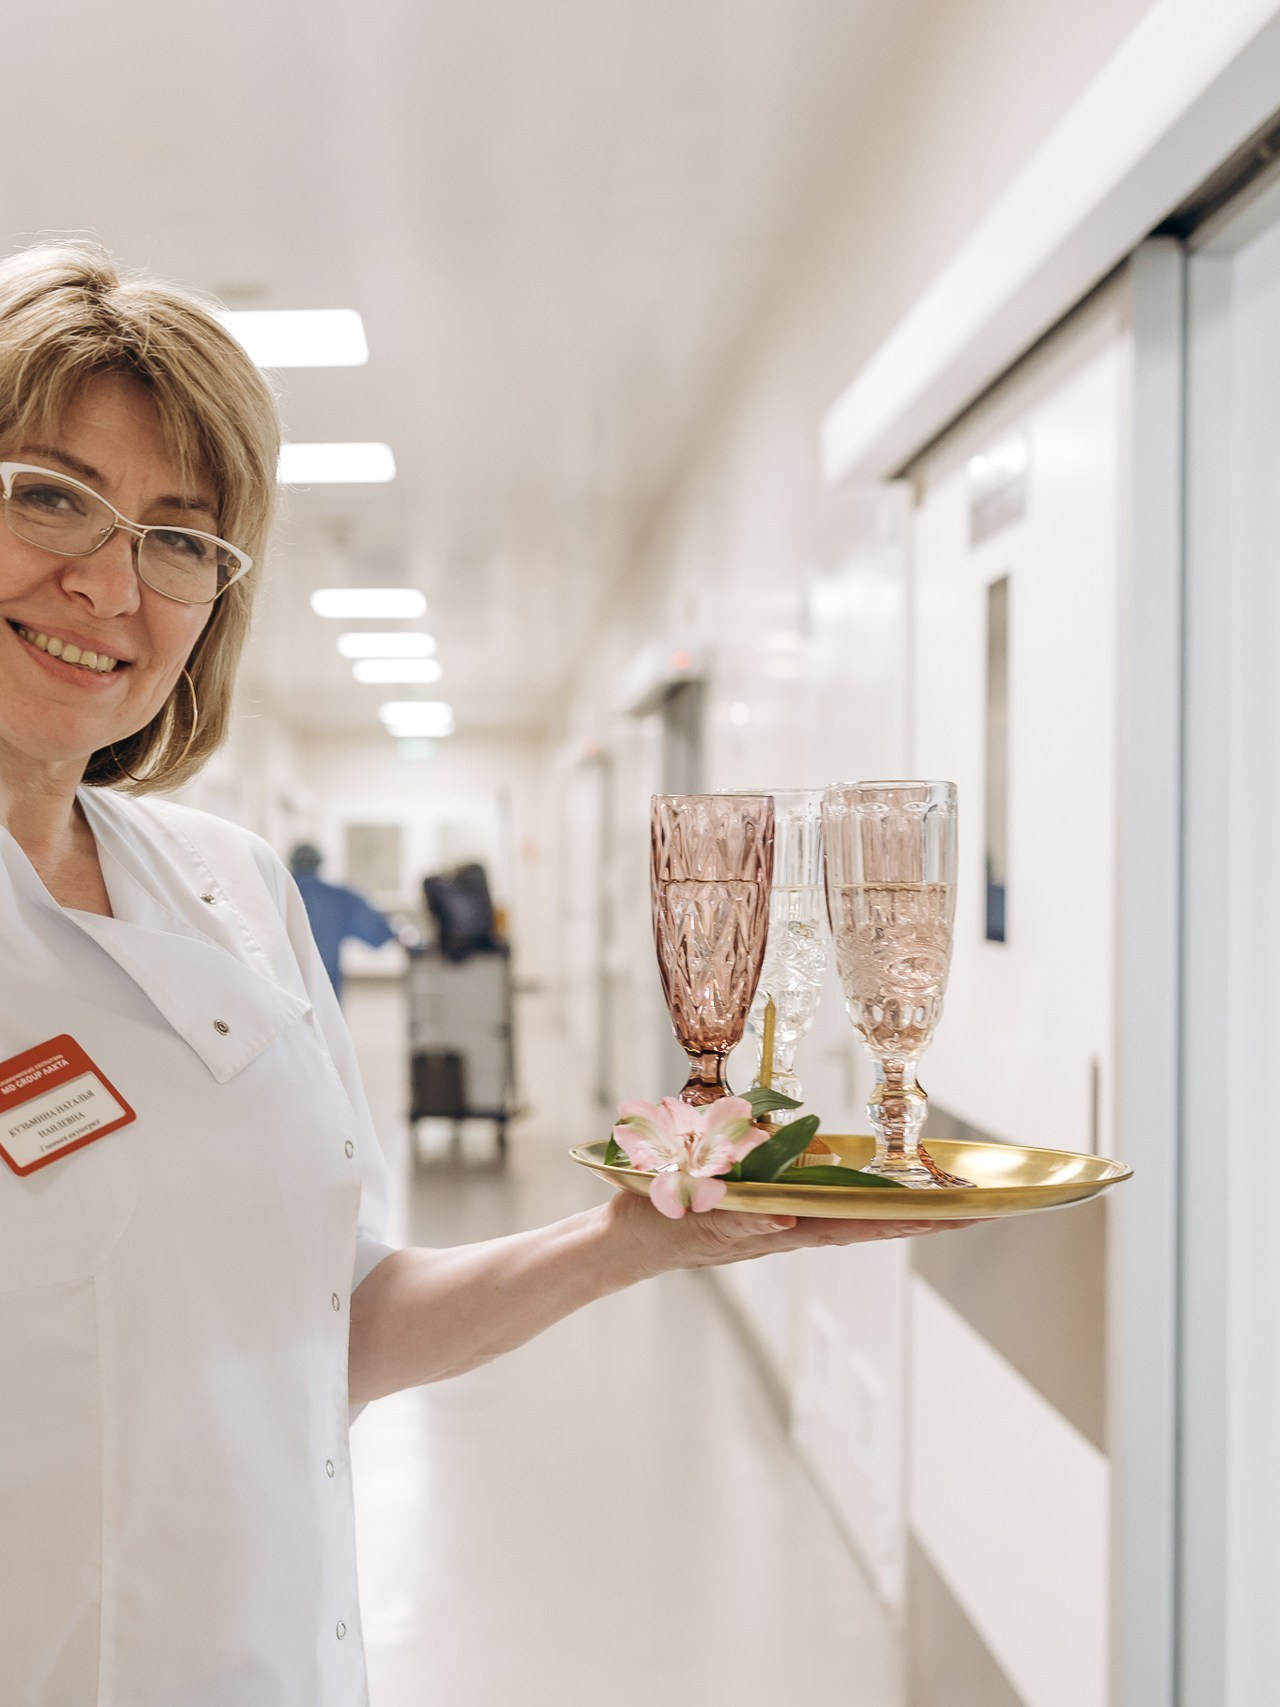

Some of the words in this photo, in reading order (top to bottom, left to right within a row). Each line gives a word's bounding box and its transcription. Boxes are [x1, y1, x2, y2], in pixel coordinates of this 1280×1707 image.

[0, 1083, 17, 1095] MD
[15, 1070, 42, 1088] GROUP
[8, 1110, 58, 1137] КУЗЬМИНА
[55, 1089, 95, 1114] НАТАЛЬЯ
